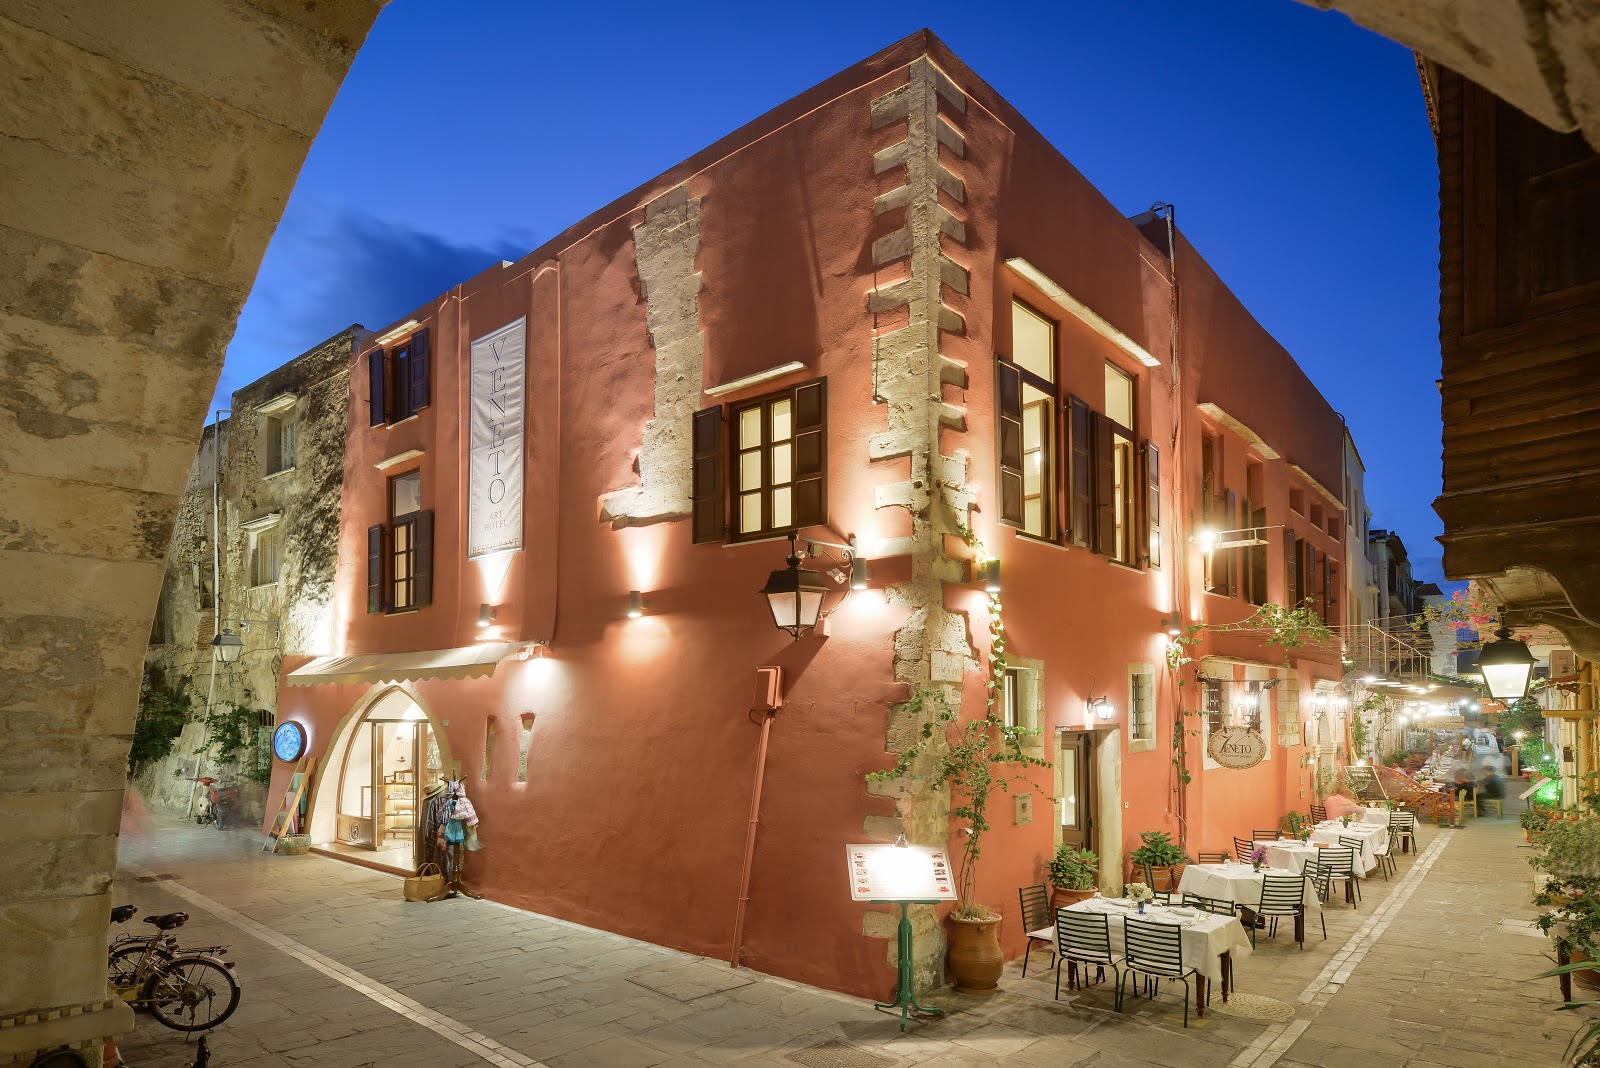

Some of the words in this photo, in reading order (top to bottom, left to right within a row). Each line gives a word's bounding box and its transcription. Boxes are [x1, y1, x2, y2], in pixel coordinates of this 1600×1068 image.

[487, 336, 508, 504] VENETO
[488, 509, 504, 521] ART
[484, 519, 508, 532] HOTEL
